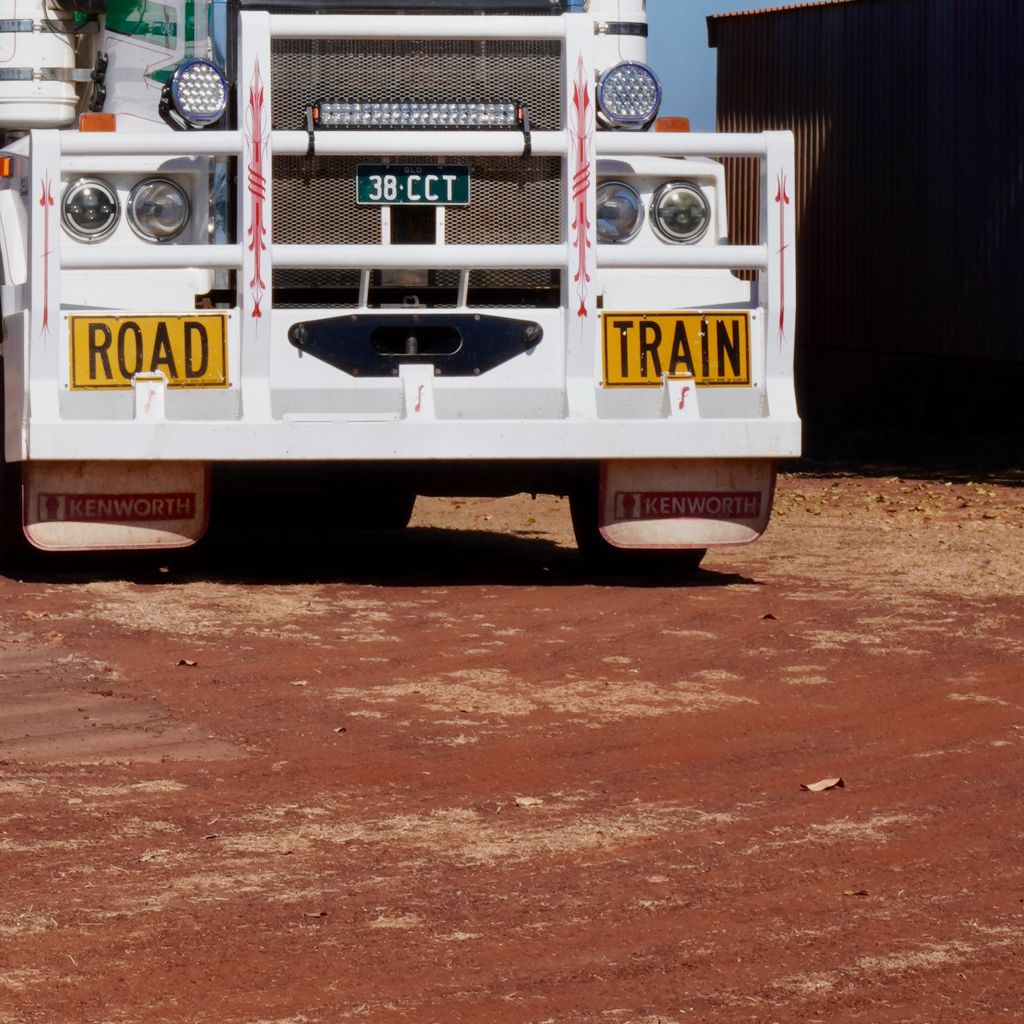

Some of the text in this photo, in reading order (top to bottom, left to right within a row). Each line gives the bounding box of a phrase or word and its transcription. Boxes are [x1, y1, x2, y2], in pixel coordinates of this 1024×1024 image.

[87, 321, 209, 380] ROAD
[613, 320, 741, 377] TRAIN
[70, 498, 191, 517] KENWORTH
[645, 496, 757, 514] KENWORTH
